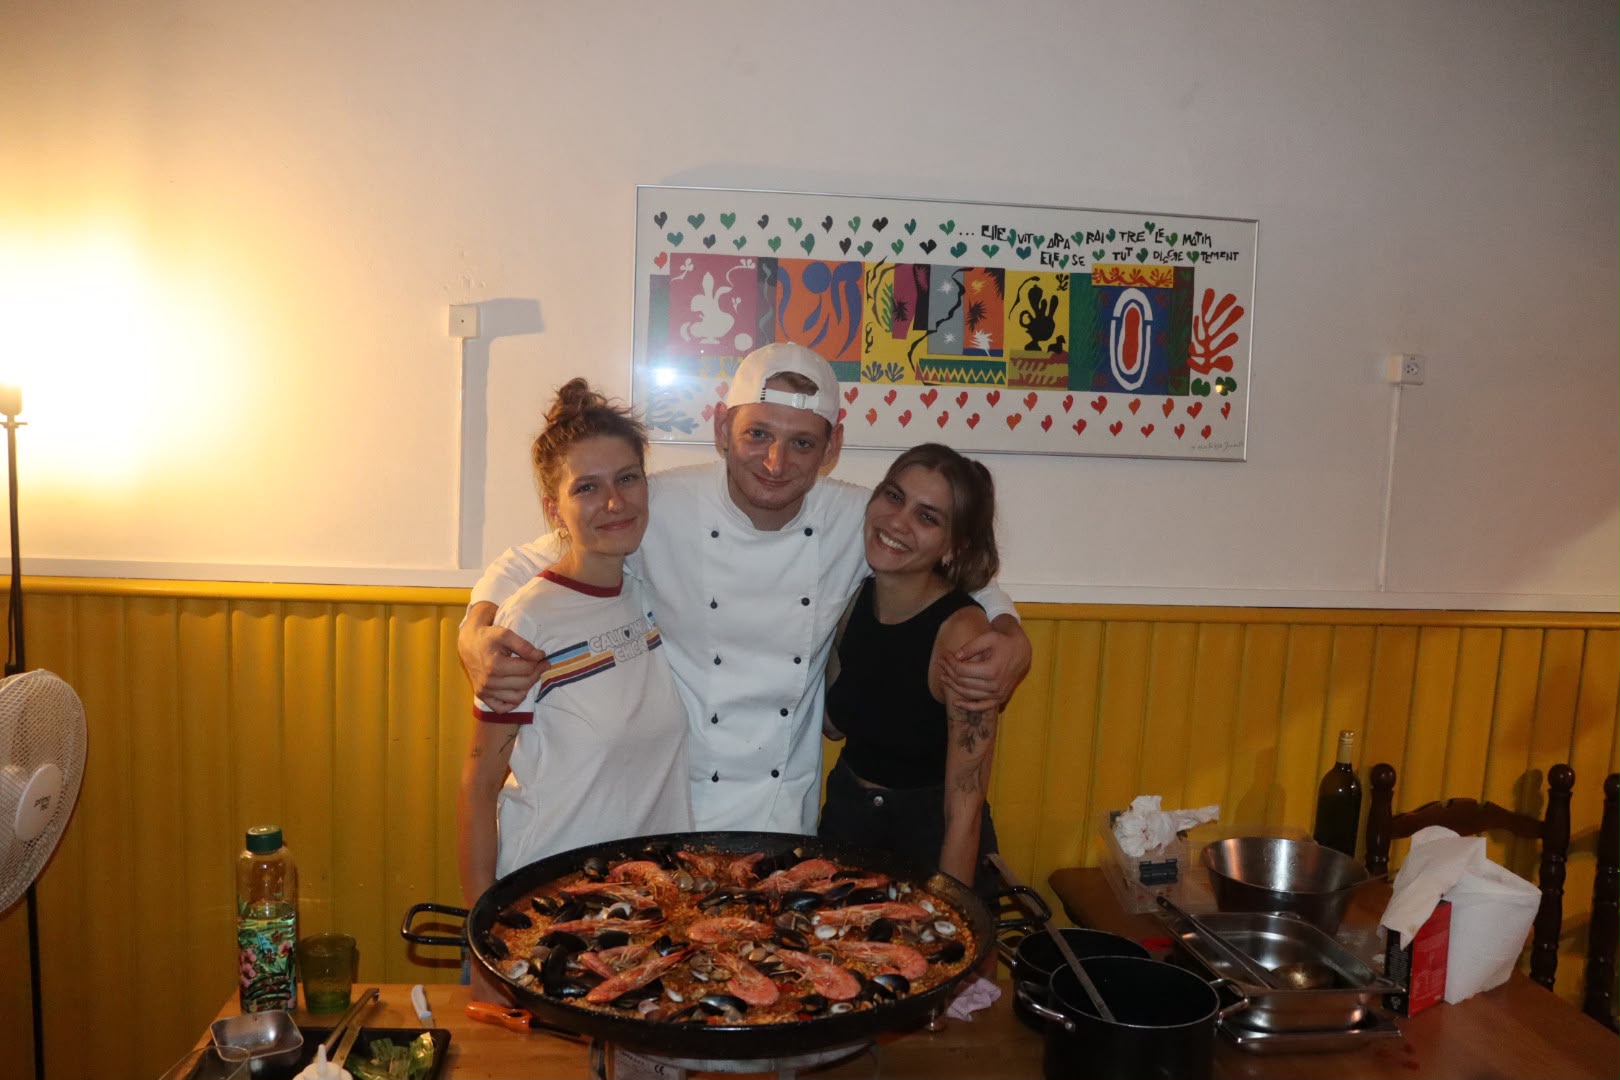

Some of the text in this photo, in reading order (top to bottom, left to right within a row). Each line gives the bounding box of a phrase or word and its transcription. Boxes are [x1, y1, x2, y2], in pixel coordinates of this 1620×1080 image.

[1017, 233, 1034, 244] VIT
[1086, 230, 1105, 244] RAI
[1119, 231, 1146, 242] TRE
[1155, 228, 1166, 243] LE
[1071, 254, 1086, 267] SE
[1112, 248, 1134, 261] TUT
[1200, 251, 1239, 263] TEMENT
[589, 617, 652, 652] CALIFORN
